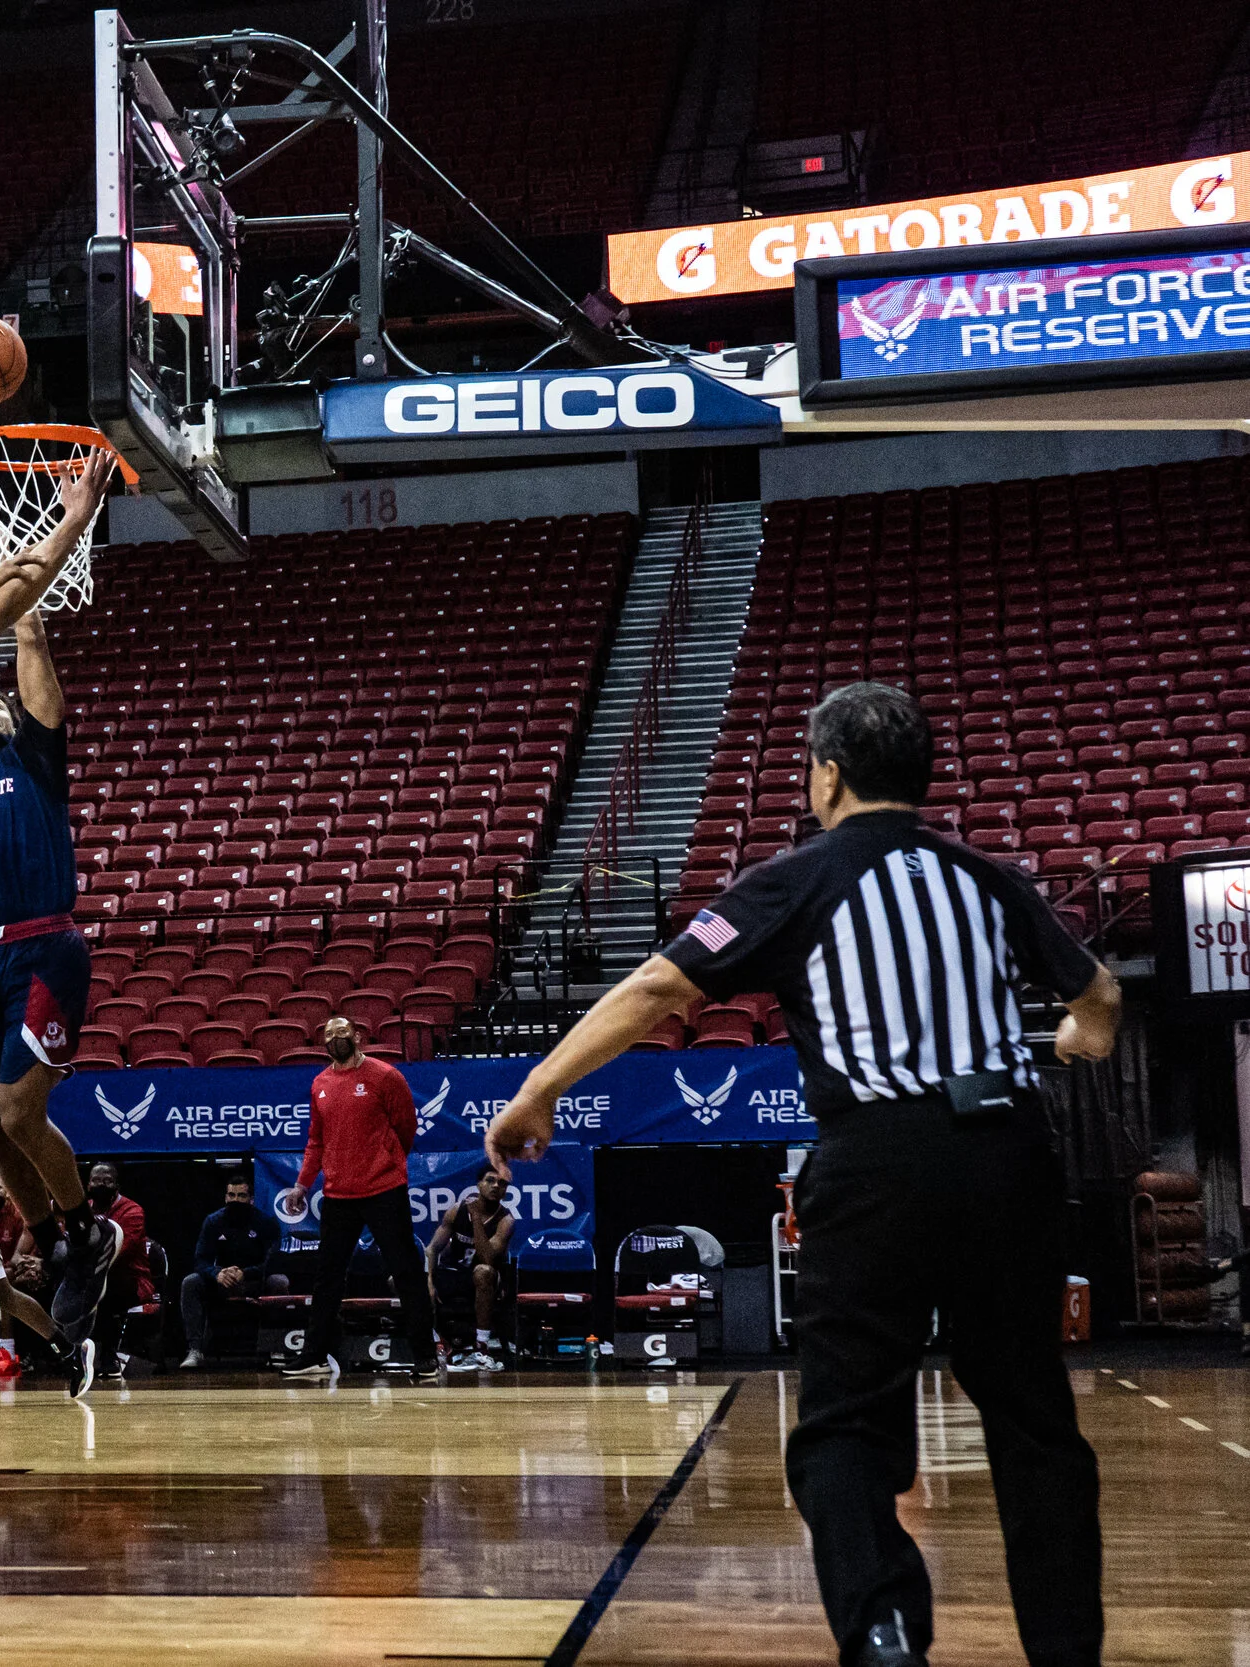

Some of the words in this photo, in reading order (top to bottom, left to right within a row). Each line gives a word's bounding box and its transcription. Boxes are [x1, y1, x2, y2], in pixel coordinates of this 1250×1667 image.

[657, 228, 717, 294] G
[749, 182, 1135, 278] GATORADE
[1171, 157, 1236, 227] G
[939, 281, 1048, 320] AIR
[960, 302, 1250, 357] RESERVE
[384, 372, 695, 434] GEICO
[341, 488, 398, 526] 118
[748, 1089, 798, 1106] AIR
[166, 1105, 213, 1122] AIR
[220, 1104, 310, 1121] FORCE
[174, 1121, 301, 1138] RESERVE
[657, 1239, 684, 1249] WEST
[284, 1329, 305, 1351] G
[368, 1338, 392, 1362] G
[643, 1333, 667, 1357] G
